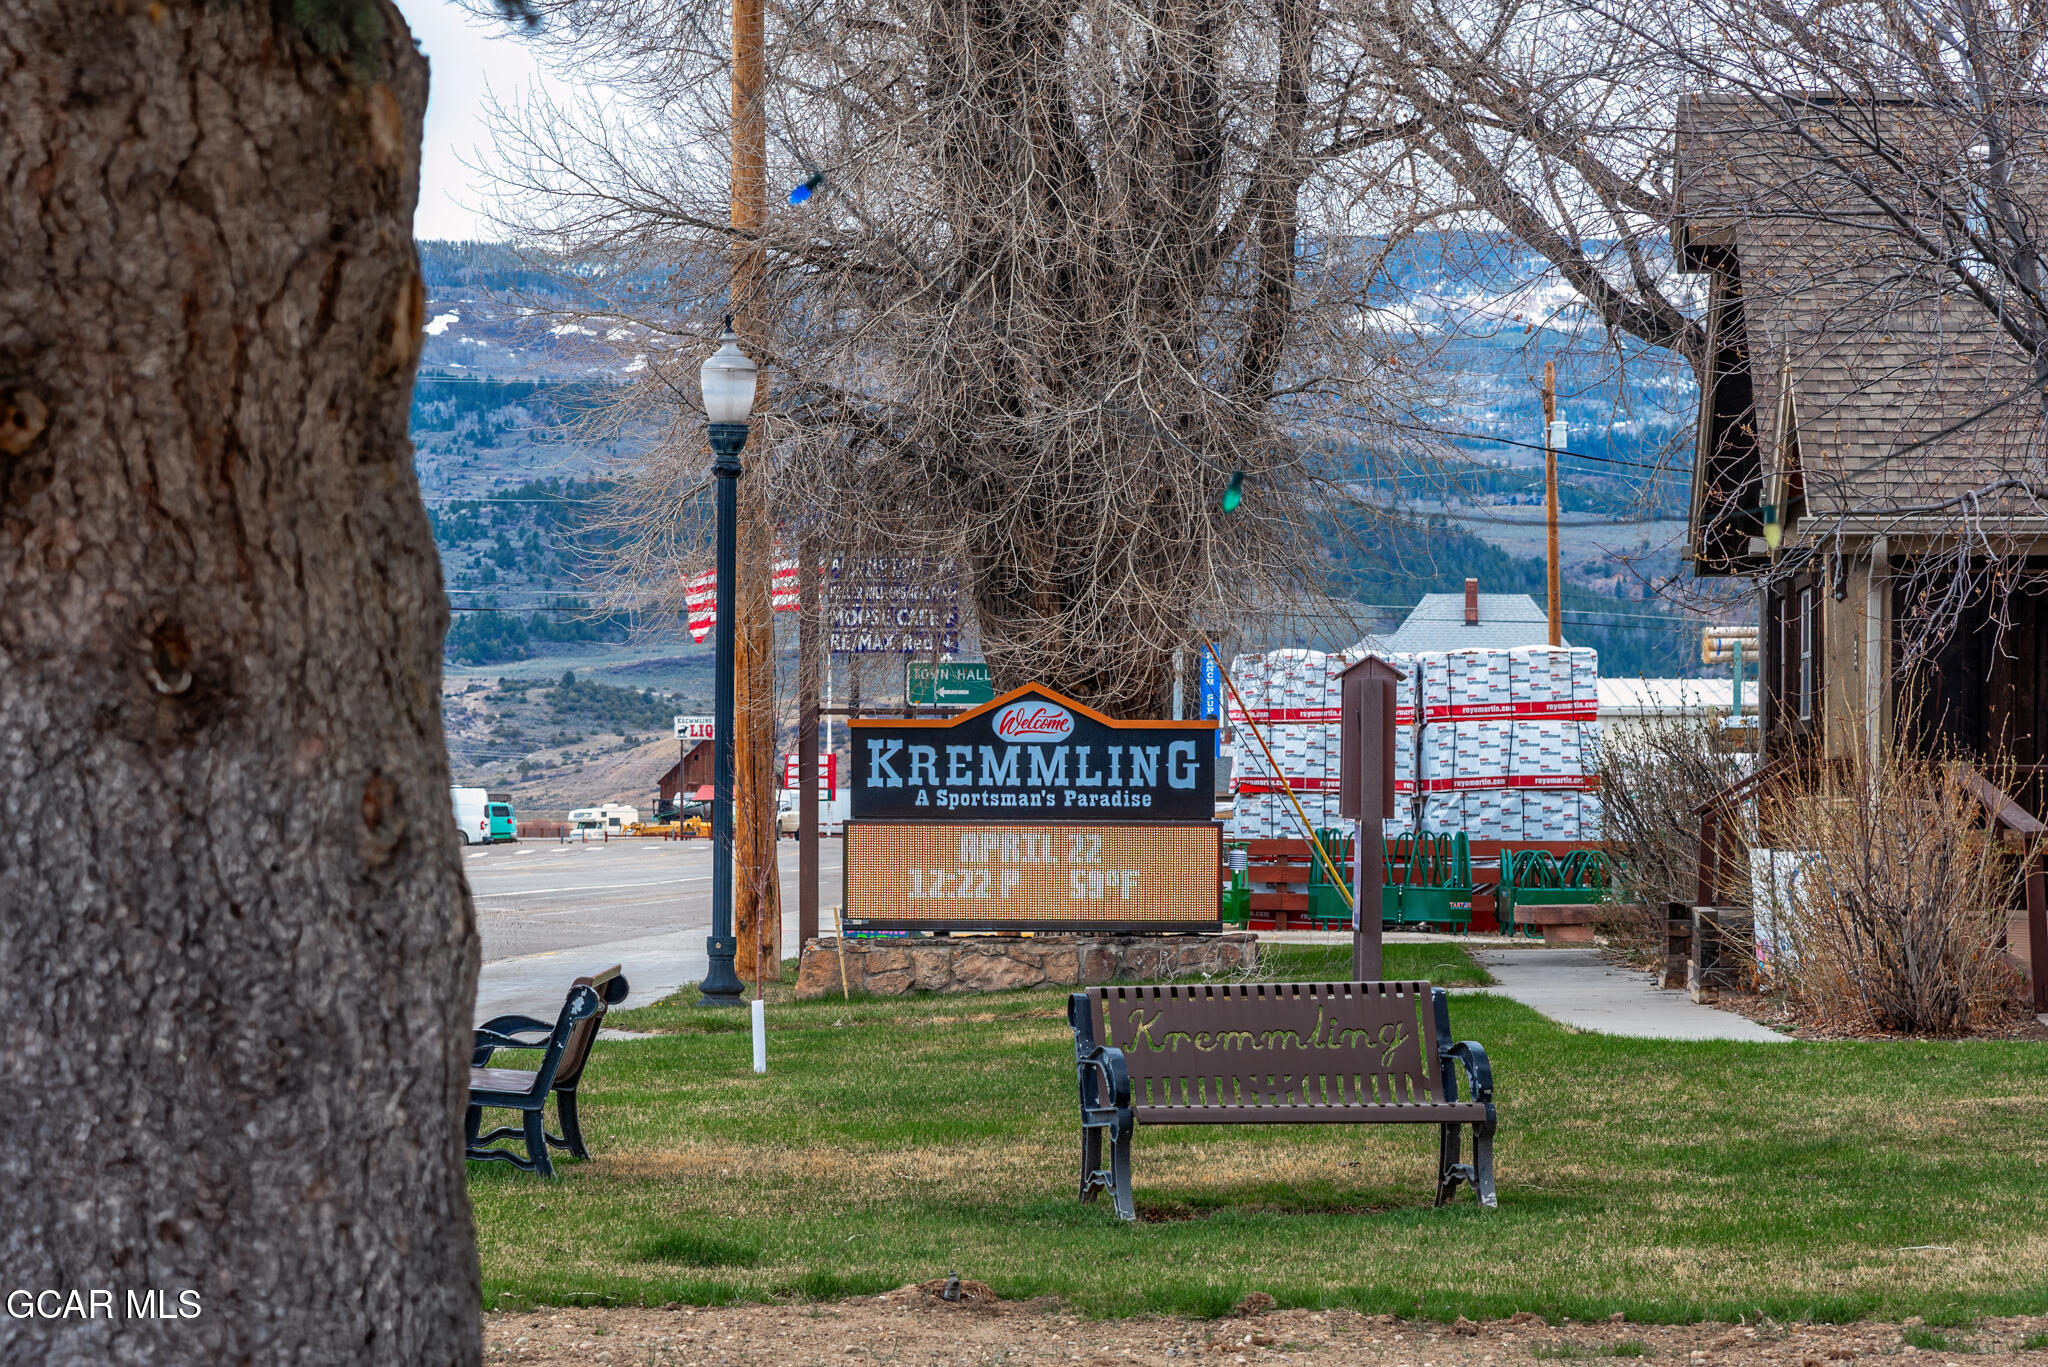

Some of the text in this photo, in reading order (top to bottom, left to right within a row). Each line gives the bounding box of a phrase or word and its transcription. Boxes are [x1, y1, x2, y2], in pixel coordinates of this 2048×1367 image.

[957, 668, 991, 680] HALL
[999, 708, 1070, 735] Welcome
[867, 738, 1200, 789] KREMMLING
[915, 789, 1152, 810] A Sportsman's Paradise
[959, 832, 1102, 863] APRIL 22
[907, 868, 992, 899] 12:22
[1000, 868, 1020, 899] P
[1123, 1004, 1409, 1068] Kremmling
